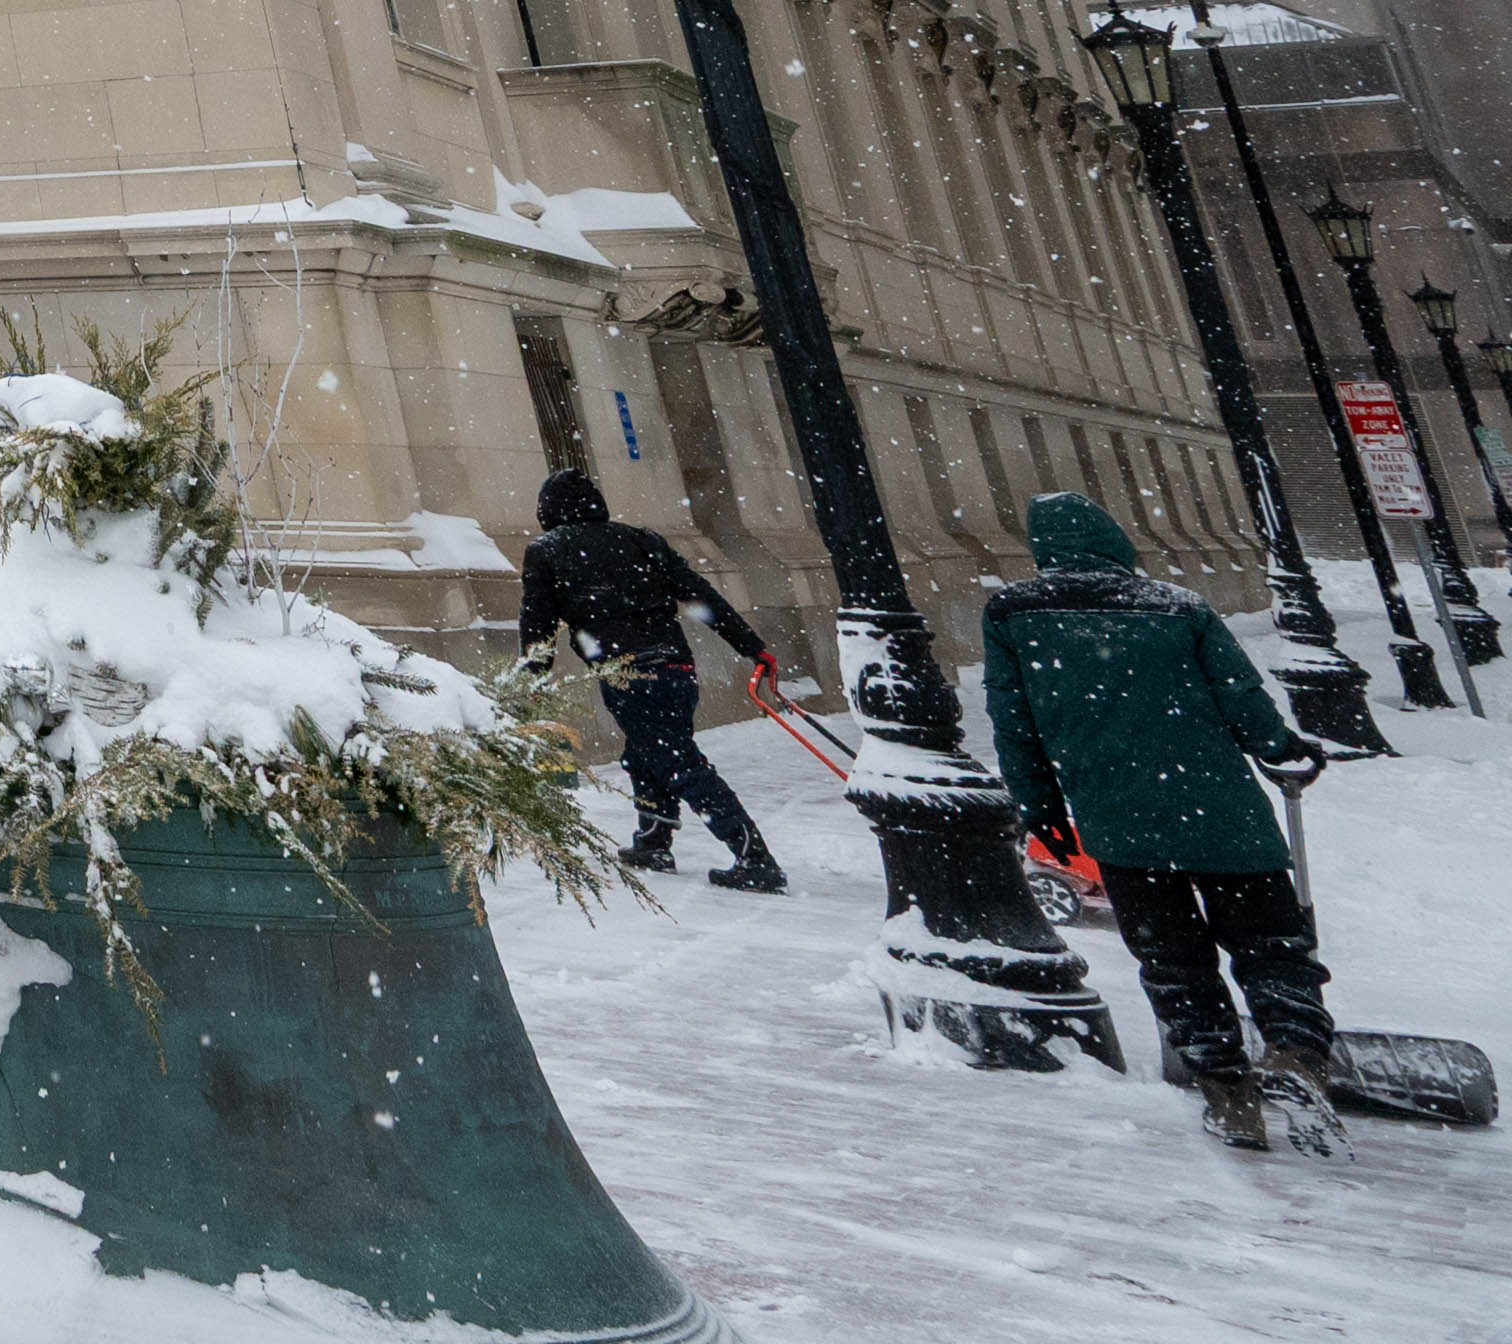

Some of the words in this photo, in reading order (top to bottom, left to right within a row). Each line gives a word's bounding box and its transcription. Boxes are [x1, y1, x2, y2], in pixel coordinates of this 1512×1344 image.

[1344, 406, 1395, 415] TOW-AWAY
[1361, 420, 1389, 429] ZONE
[1369, 453, 1404, 462] VALET
[1371, 464, 1409, 472] PARKING
